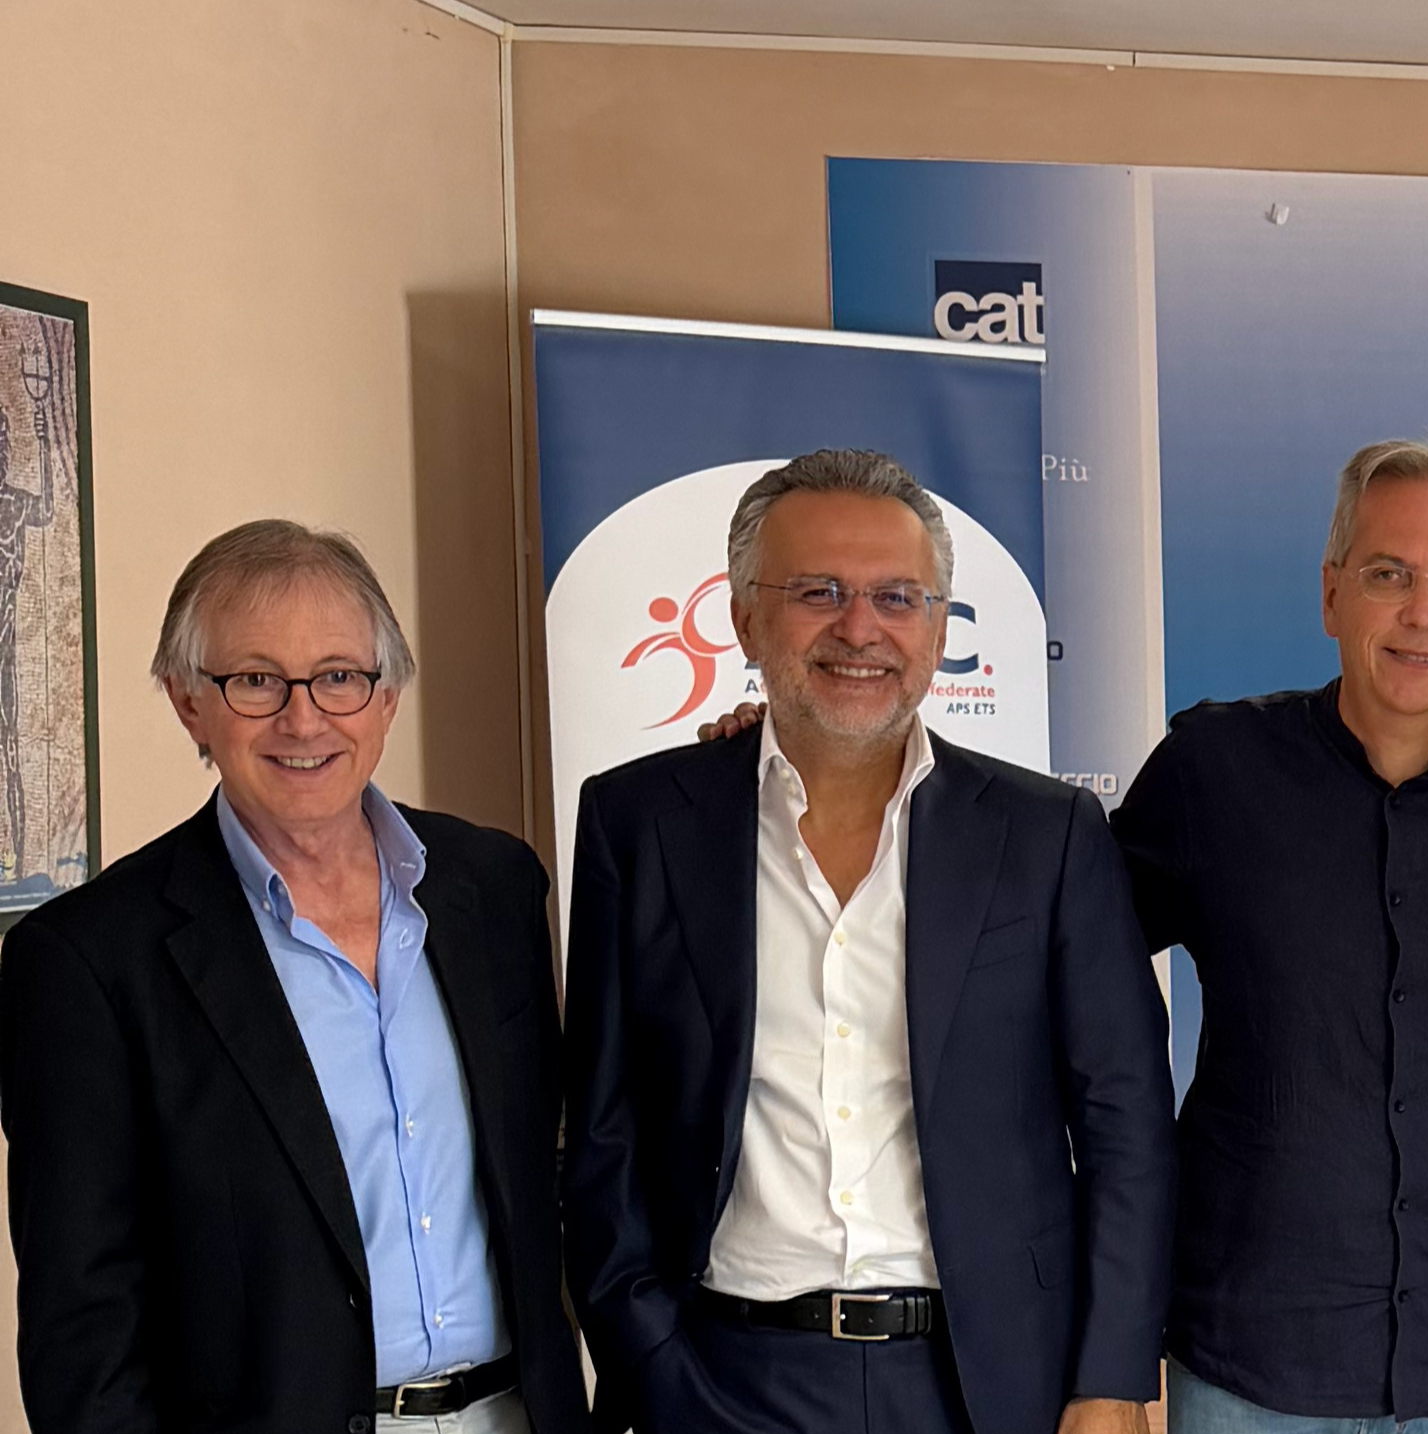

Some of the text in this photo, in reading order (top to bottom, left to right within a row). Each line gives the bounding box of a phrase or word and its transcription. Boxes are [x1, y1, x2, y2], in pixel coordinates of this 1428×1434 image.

[934, 281, 1045, 344] cat
[946, 703, 995, 715] APS ETS
